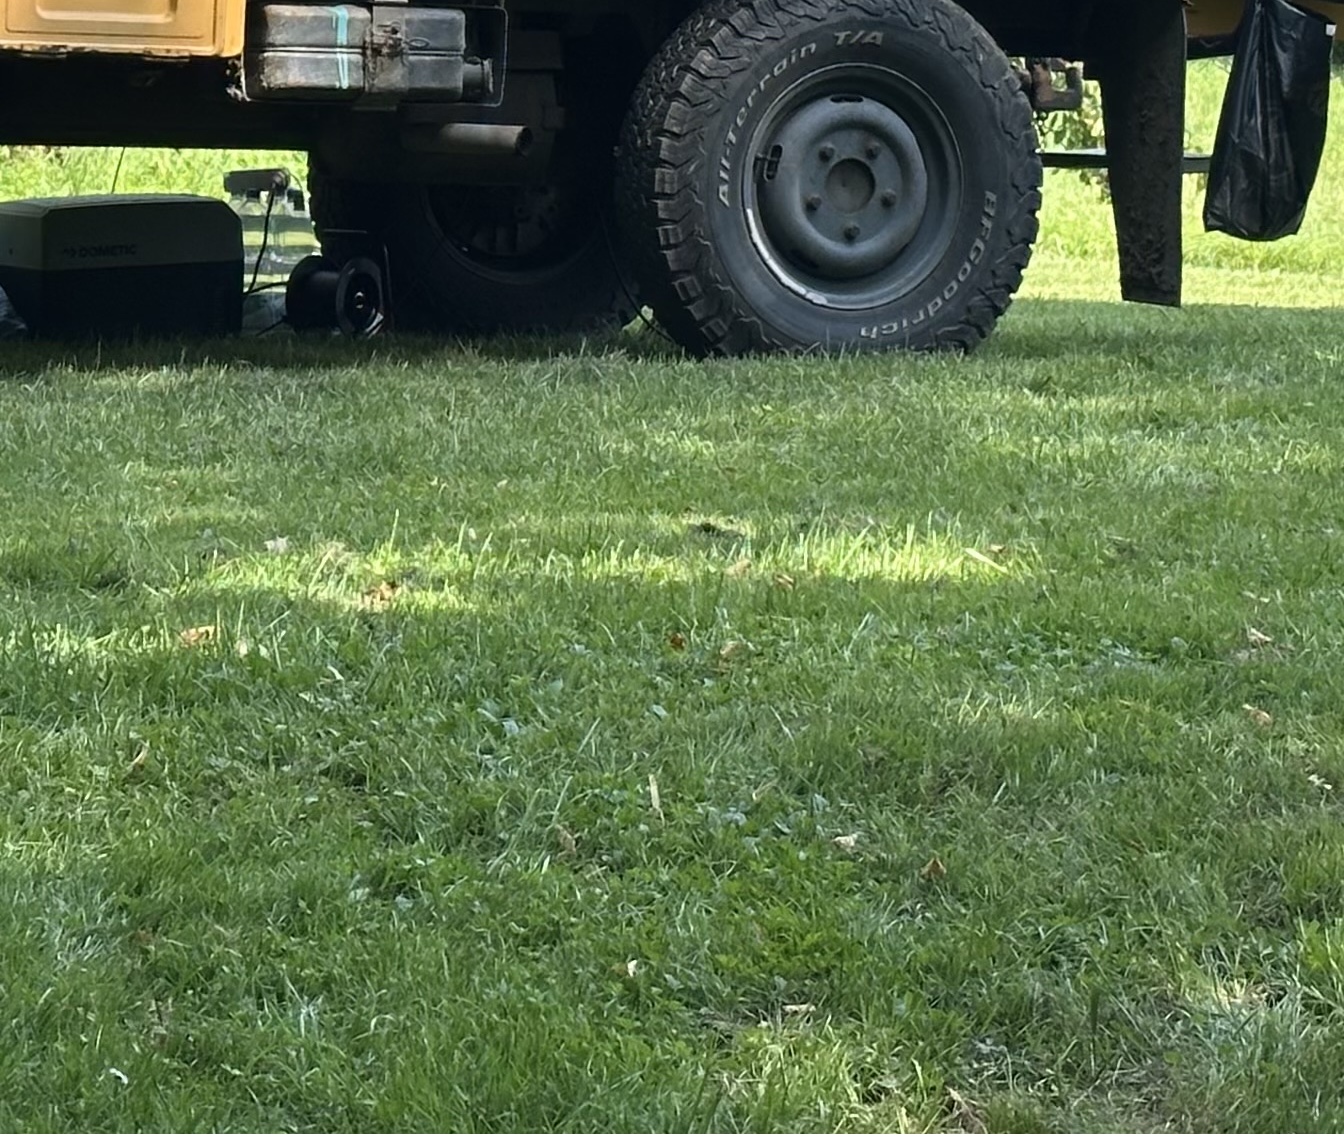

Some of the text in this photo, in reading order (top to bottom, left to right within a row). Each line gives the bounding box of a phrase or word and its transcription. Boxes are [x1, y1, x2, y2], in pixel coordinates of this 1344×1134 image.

[718, 30, 885, 208] All-Terrain T/A
[78, 243, 137, 259] DOMETIC
[859, 189, 998, 339] BFGoodrich
